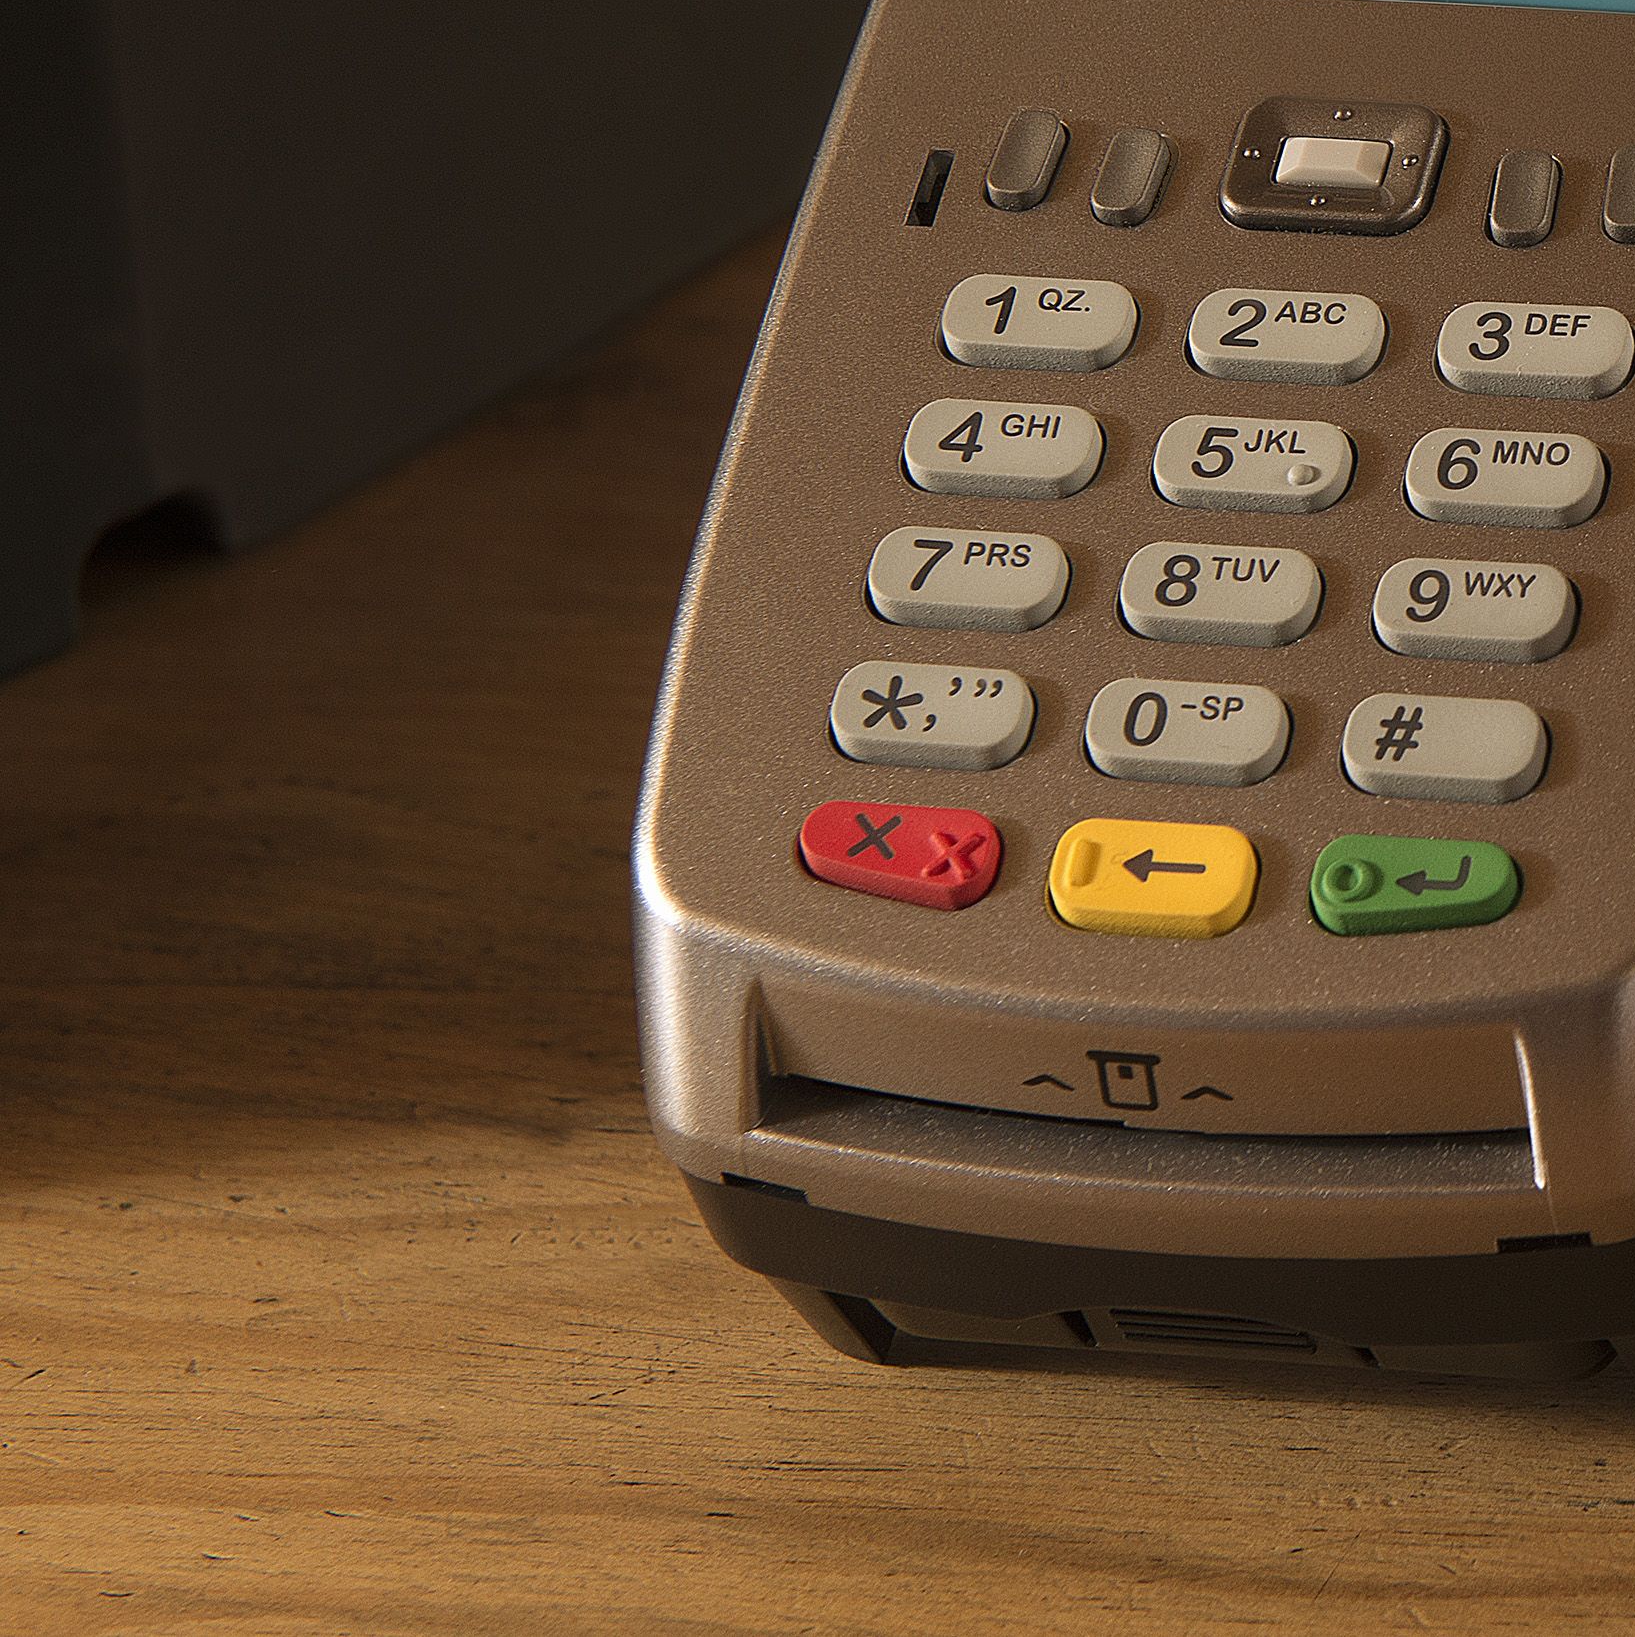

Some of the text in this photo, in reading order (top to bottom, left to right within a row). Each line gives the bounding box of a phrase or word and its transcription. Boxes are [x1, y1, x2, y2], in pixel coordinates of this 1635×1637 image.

[984, 285, 1092, 335] 1 QZ.
[1219, 298, 1349, 348] 2 ABC
[1468, 311, 1591, 361] 3 DEF
[938, 410, 1062, 464] 4 GHI
[1190, 426, 1308, 478] 5 JKL
[1435, 438, 1571, 490] 6 MNO
[910, 539, 1033, 592] 7 PRS
[1155, 554, 1280, 608] 8 TUV
[1406, 569, 1536, 624] 9 WXY
[1123, 692, 1167, 747] 0
[1374, 706, 1423, 760] #
